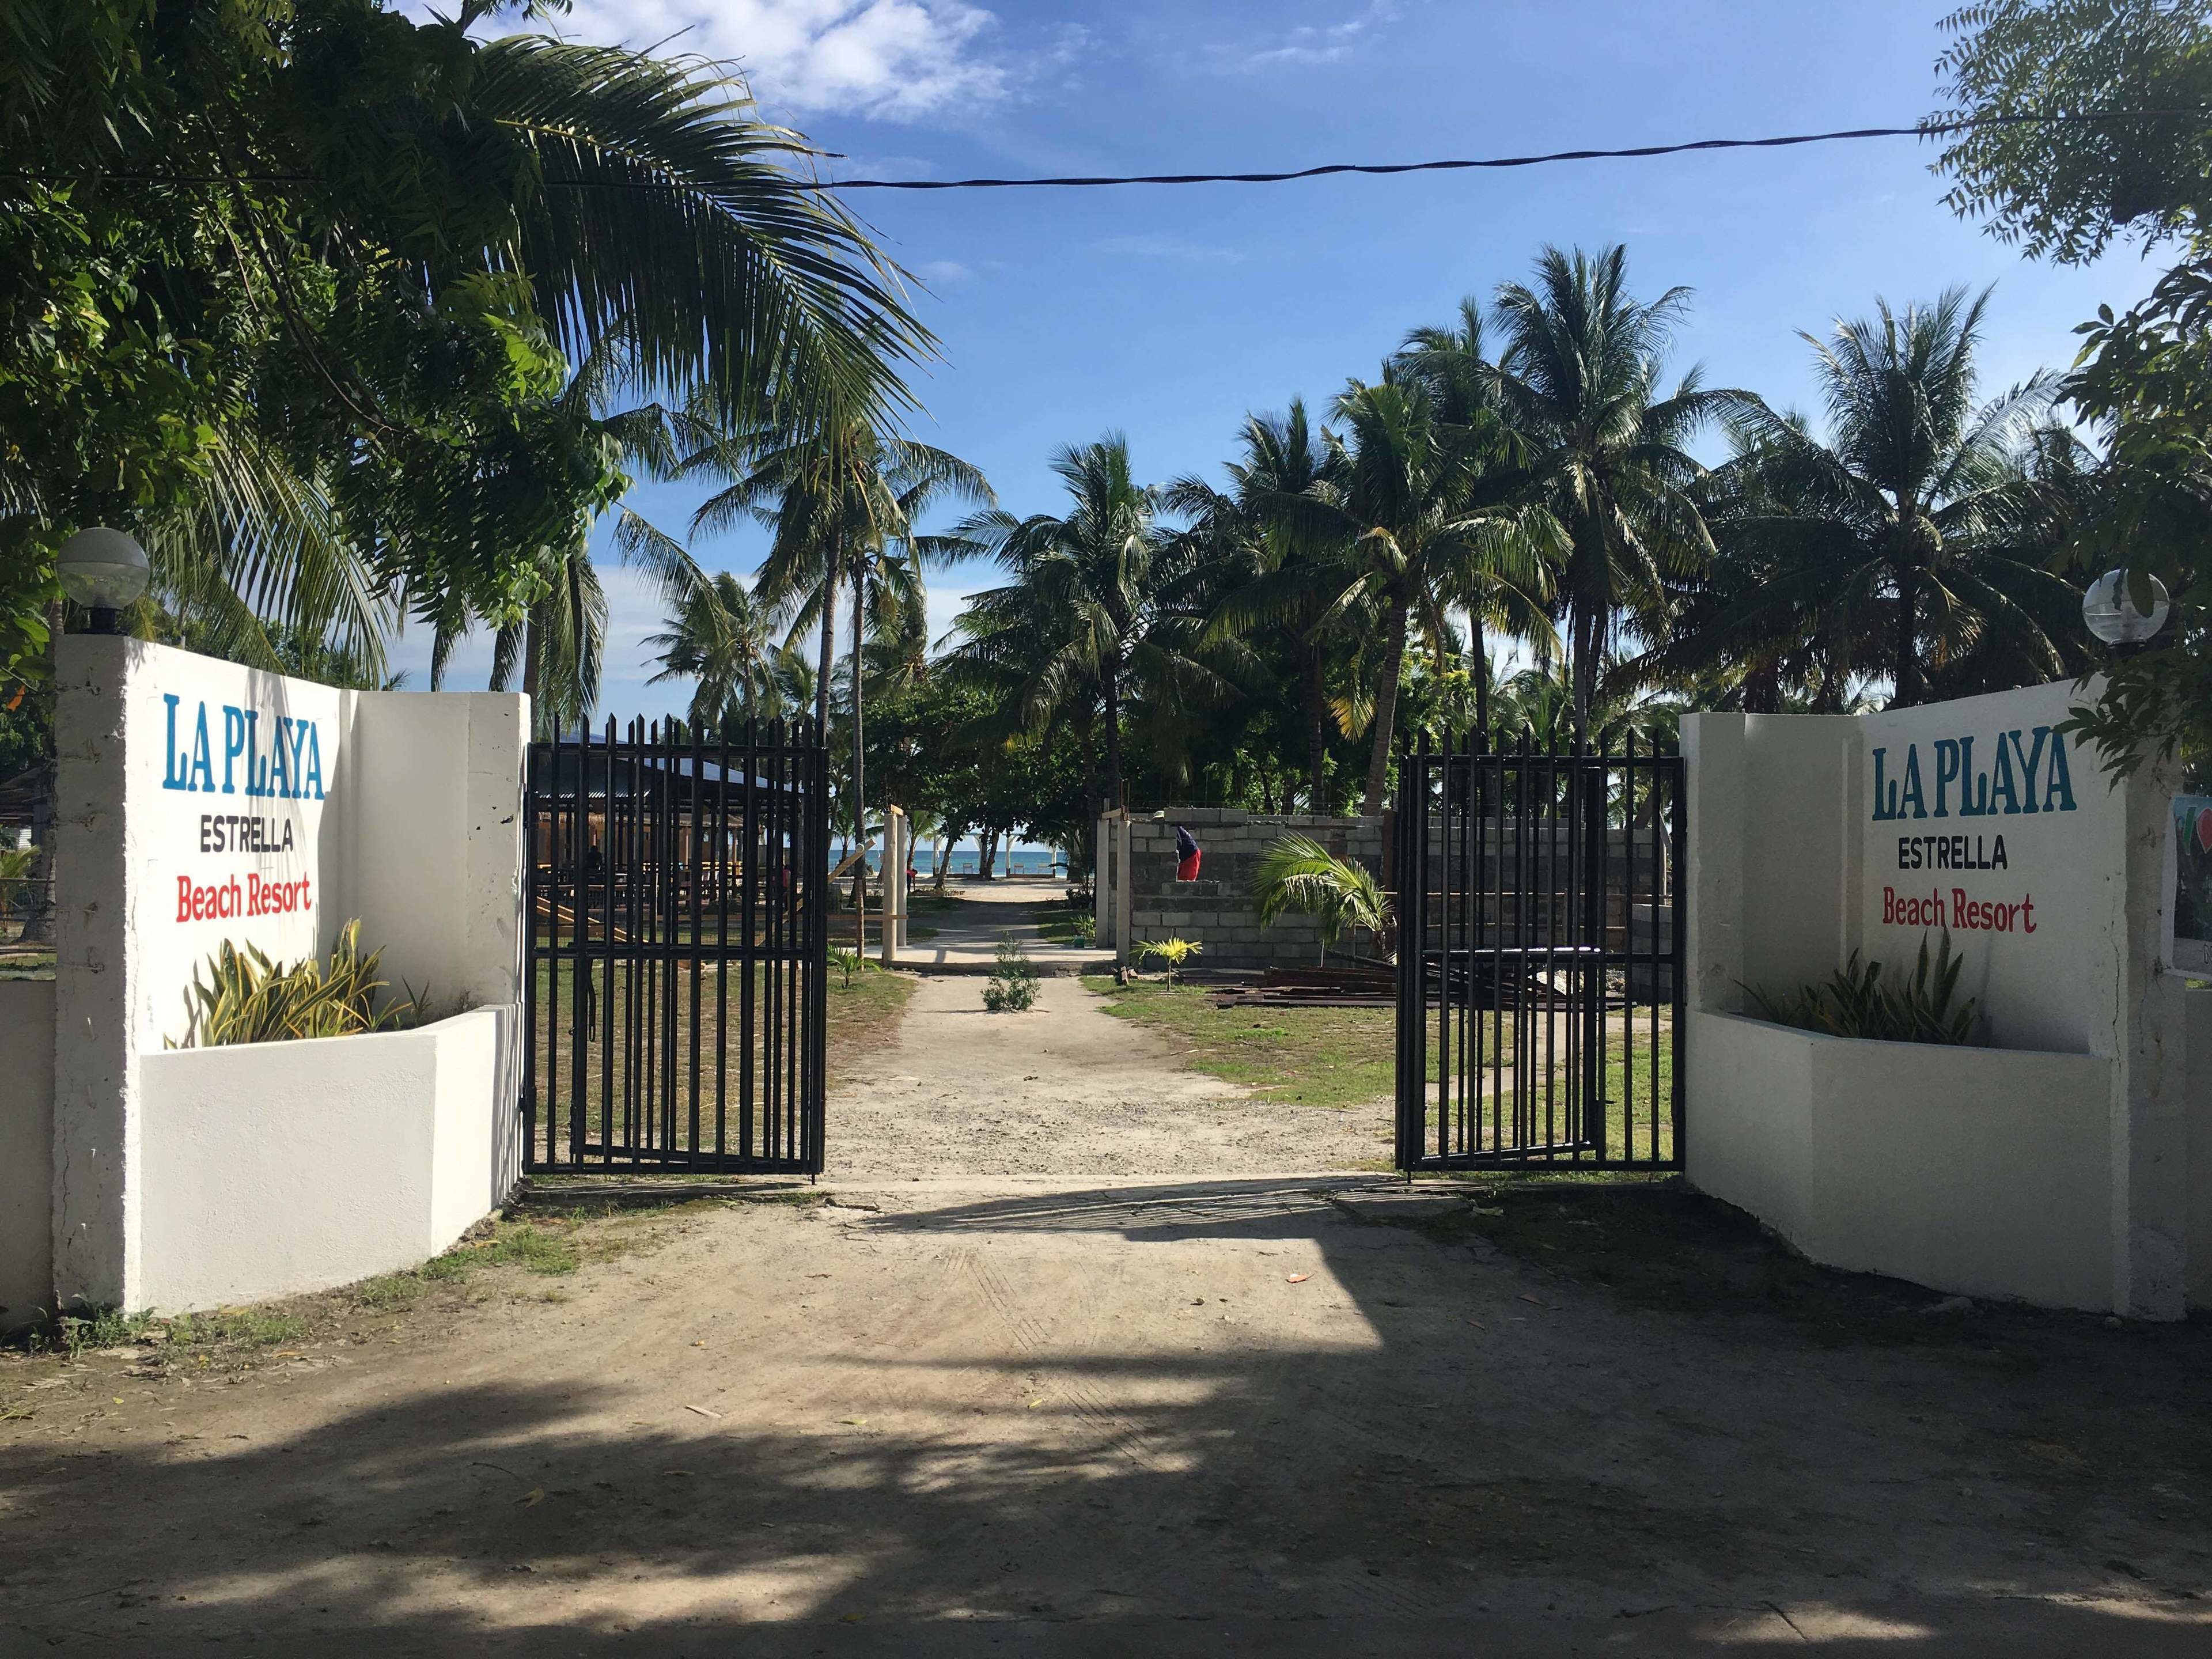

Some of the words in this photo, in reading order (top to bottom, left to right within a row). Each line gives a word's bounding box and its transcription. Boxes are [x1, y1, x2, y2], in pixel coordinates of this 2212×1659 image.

[162, 693, 215, 793] LA
[222, 704, 325, 800] PLAYA
[1872, 743, 1927, 821] LA
[1933, 726, 2077, 817] PLAYA
[200, 815, 293, 853] ESTRELLA
[1898, 834, 2008, 870] ESTRELLA
[176, 873, 241, 923] Beach
[247, 871, 312, 917] Resort
[1883, 887, 1946, 926] Beach
[1952, 888, 2037, 934] Resort
